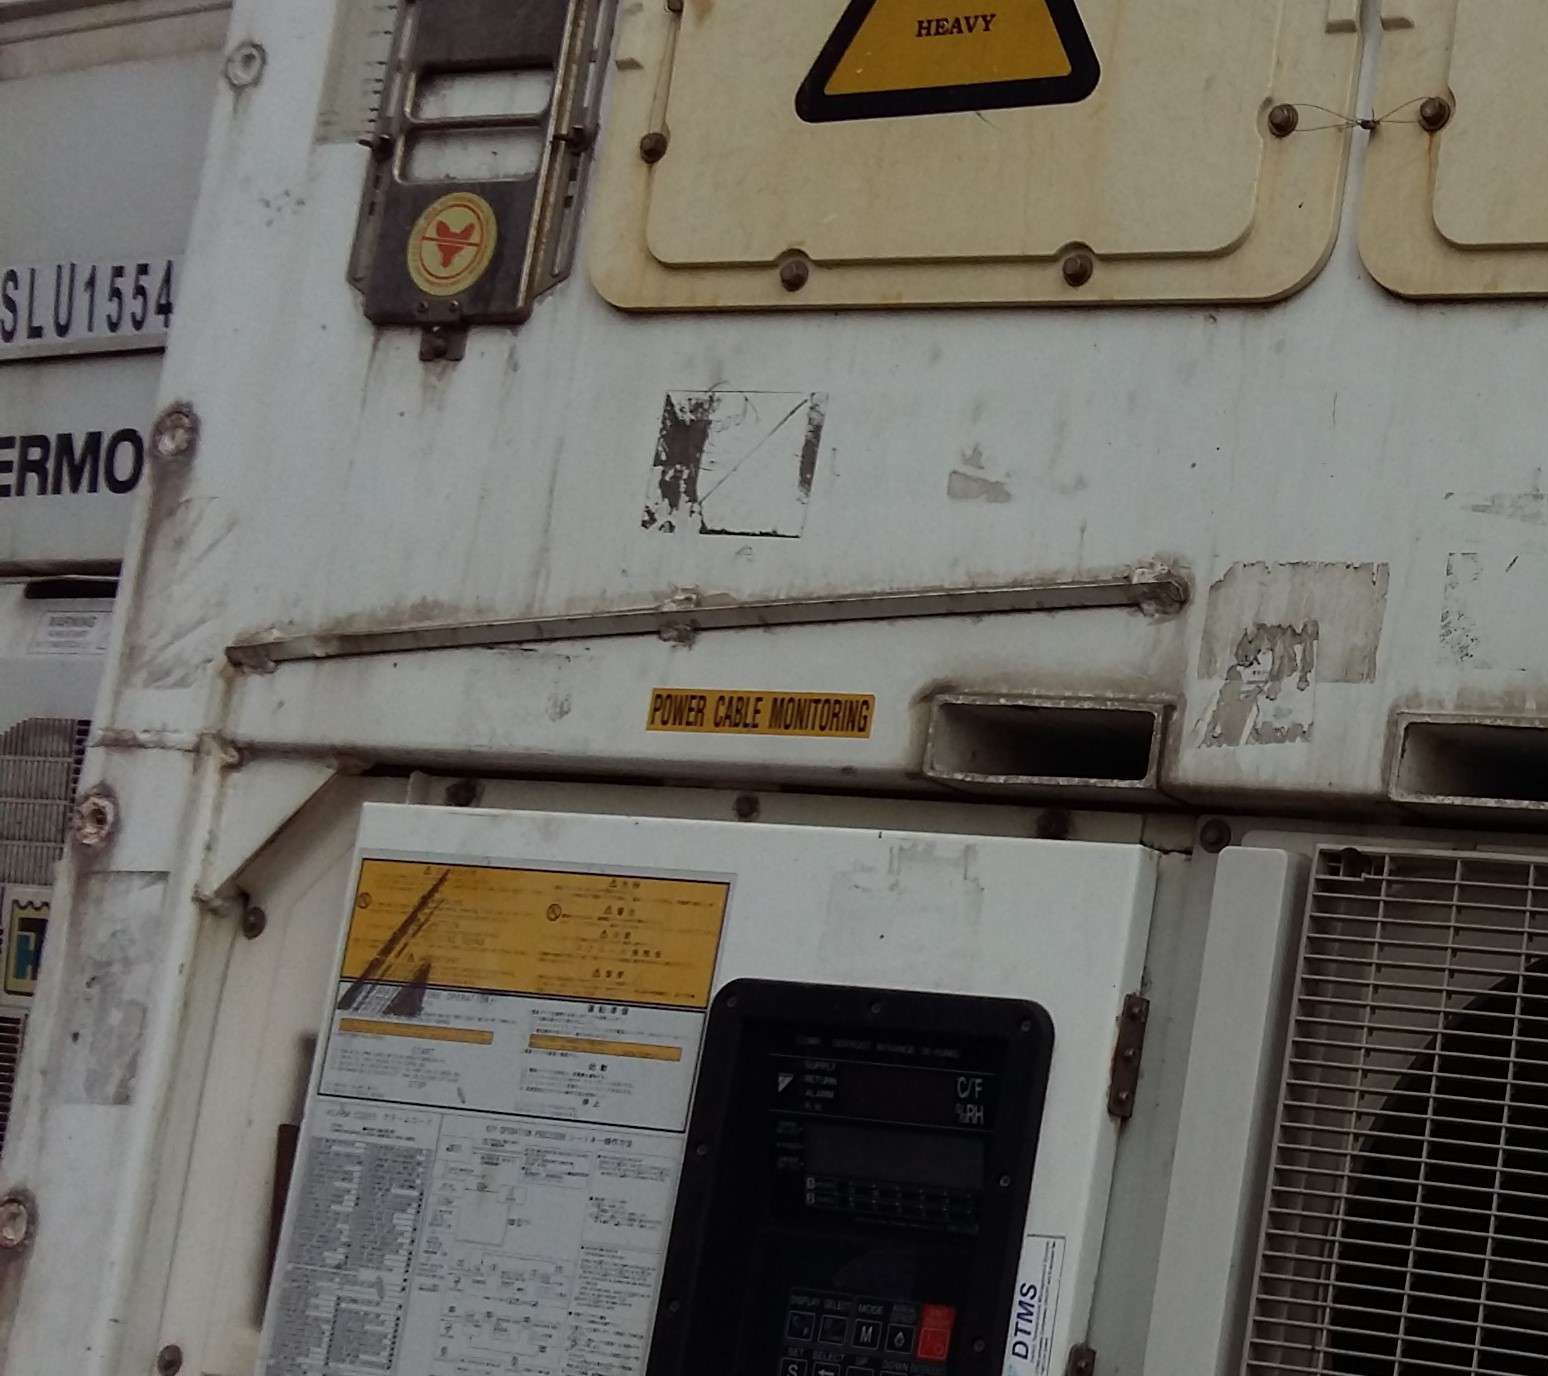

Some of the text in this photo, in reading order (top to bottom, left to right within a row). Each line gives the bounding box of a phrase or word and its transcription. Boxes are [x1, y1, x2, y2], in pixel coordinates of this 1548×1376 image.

[916, 14, 997, 37] HEAVY
[0, 260, 174, 343] SLU1554
[650, 693, 870, 732] POWER CABLE MONITORING
[1011, 1282, 1037, 1360] DTMS
